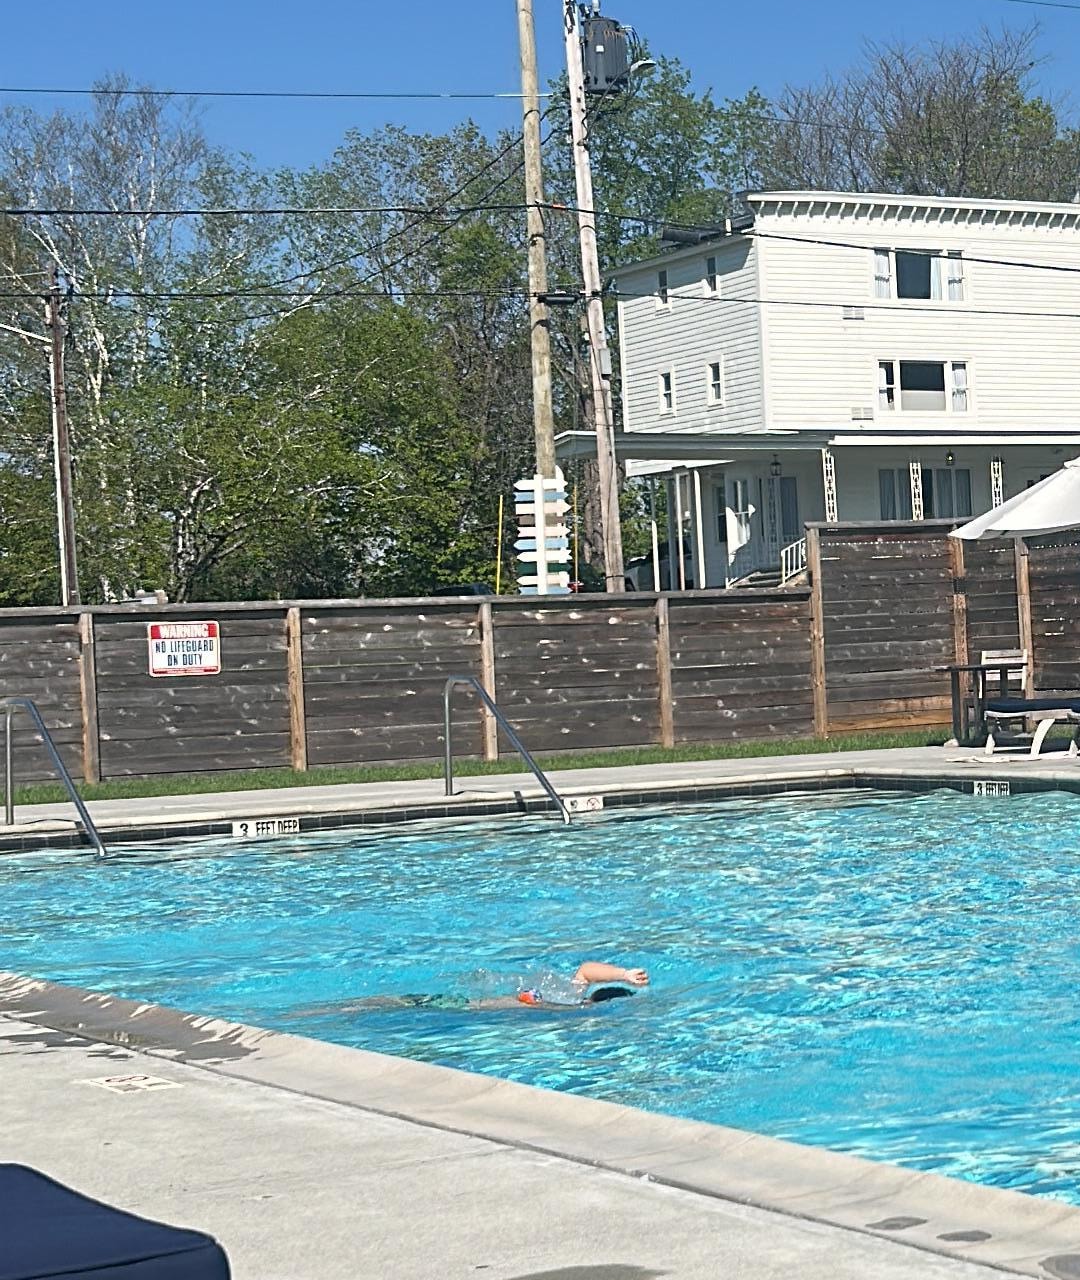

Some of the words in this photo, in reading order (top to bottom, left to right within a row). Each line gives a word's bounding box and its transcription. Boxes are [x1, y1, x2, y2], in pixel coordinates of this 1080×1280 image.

[159, 624, 209, 638] WARNING
[155, 641, 166, 653] NO
[170, 640, 214, 653] LIFEGUARD
[167, 655, 178, 666] ON
[182, 654, 203, 666] DUTY
[239, 823, 249, 836] 3
